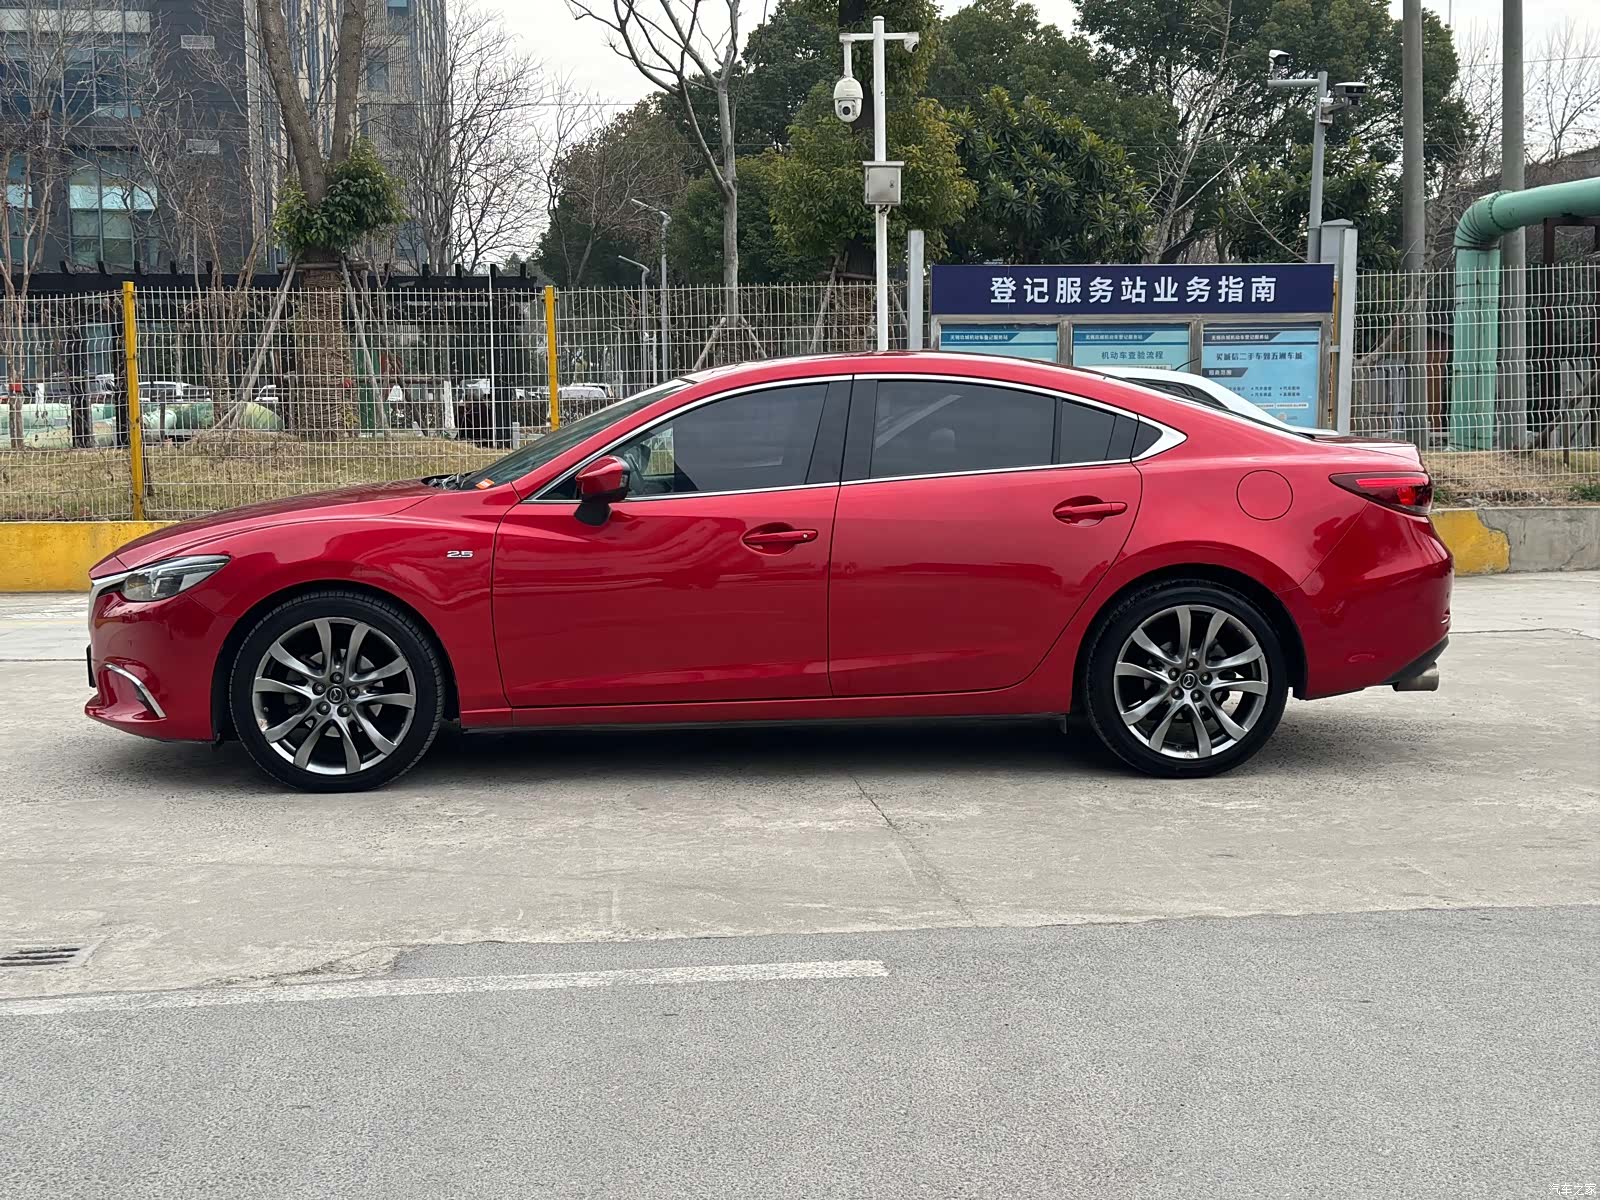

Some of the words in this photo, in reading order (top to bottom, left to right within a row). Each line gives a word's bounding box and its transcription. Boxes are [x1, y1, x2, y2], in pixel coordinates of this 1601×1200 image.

[990, 276, 1277, 303] 登记服务站业务指南
[1101, 350, 1164, 360] 机动车查验流程
